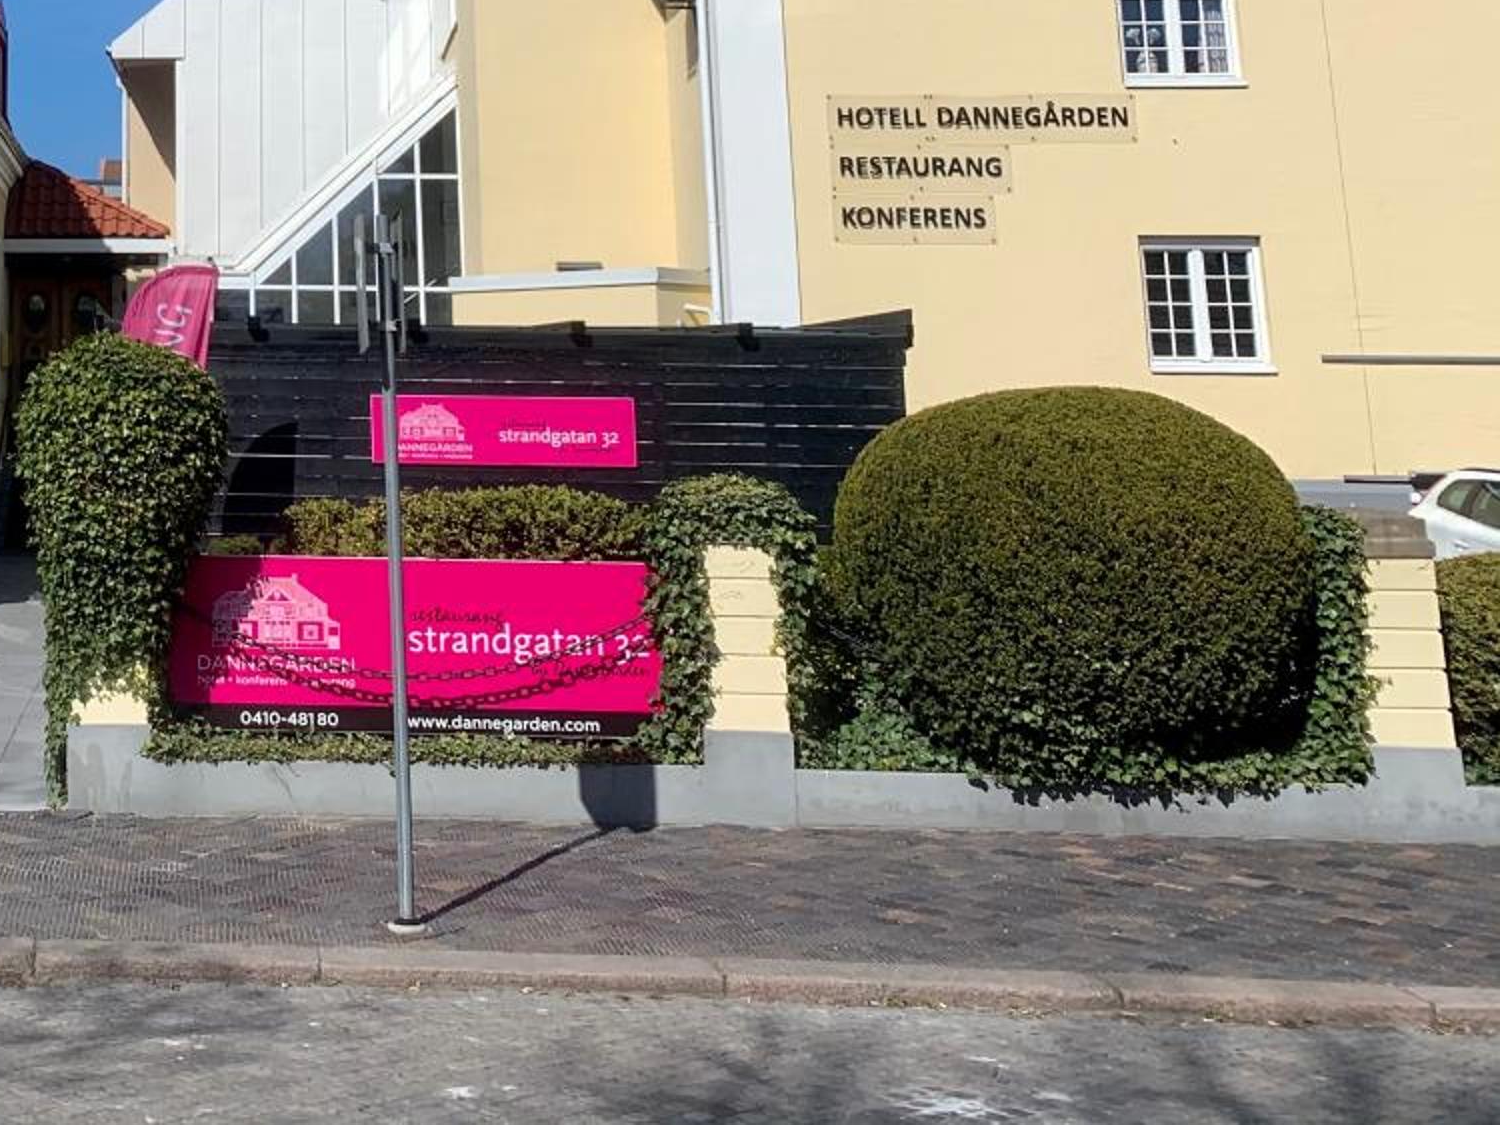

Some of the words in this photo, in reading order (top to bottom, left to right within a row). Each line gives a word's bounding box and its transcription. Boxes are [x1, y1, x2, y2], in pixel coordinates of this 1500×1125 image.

[836, 106, 927, 129] HOTELL
[937, 100, 1129, 129] DANNEGÅRDEN
[838, 156, 1002, 179] RESTAURANG
[841, 206, 987, 230] KONFERENS
[499, 427, 597, 448] strandgatan
[601, 431, 621, 449] 32
[408, 622, 604, 664] strandgatan
[407, 715, 601, 733] www.dannegarden.com
